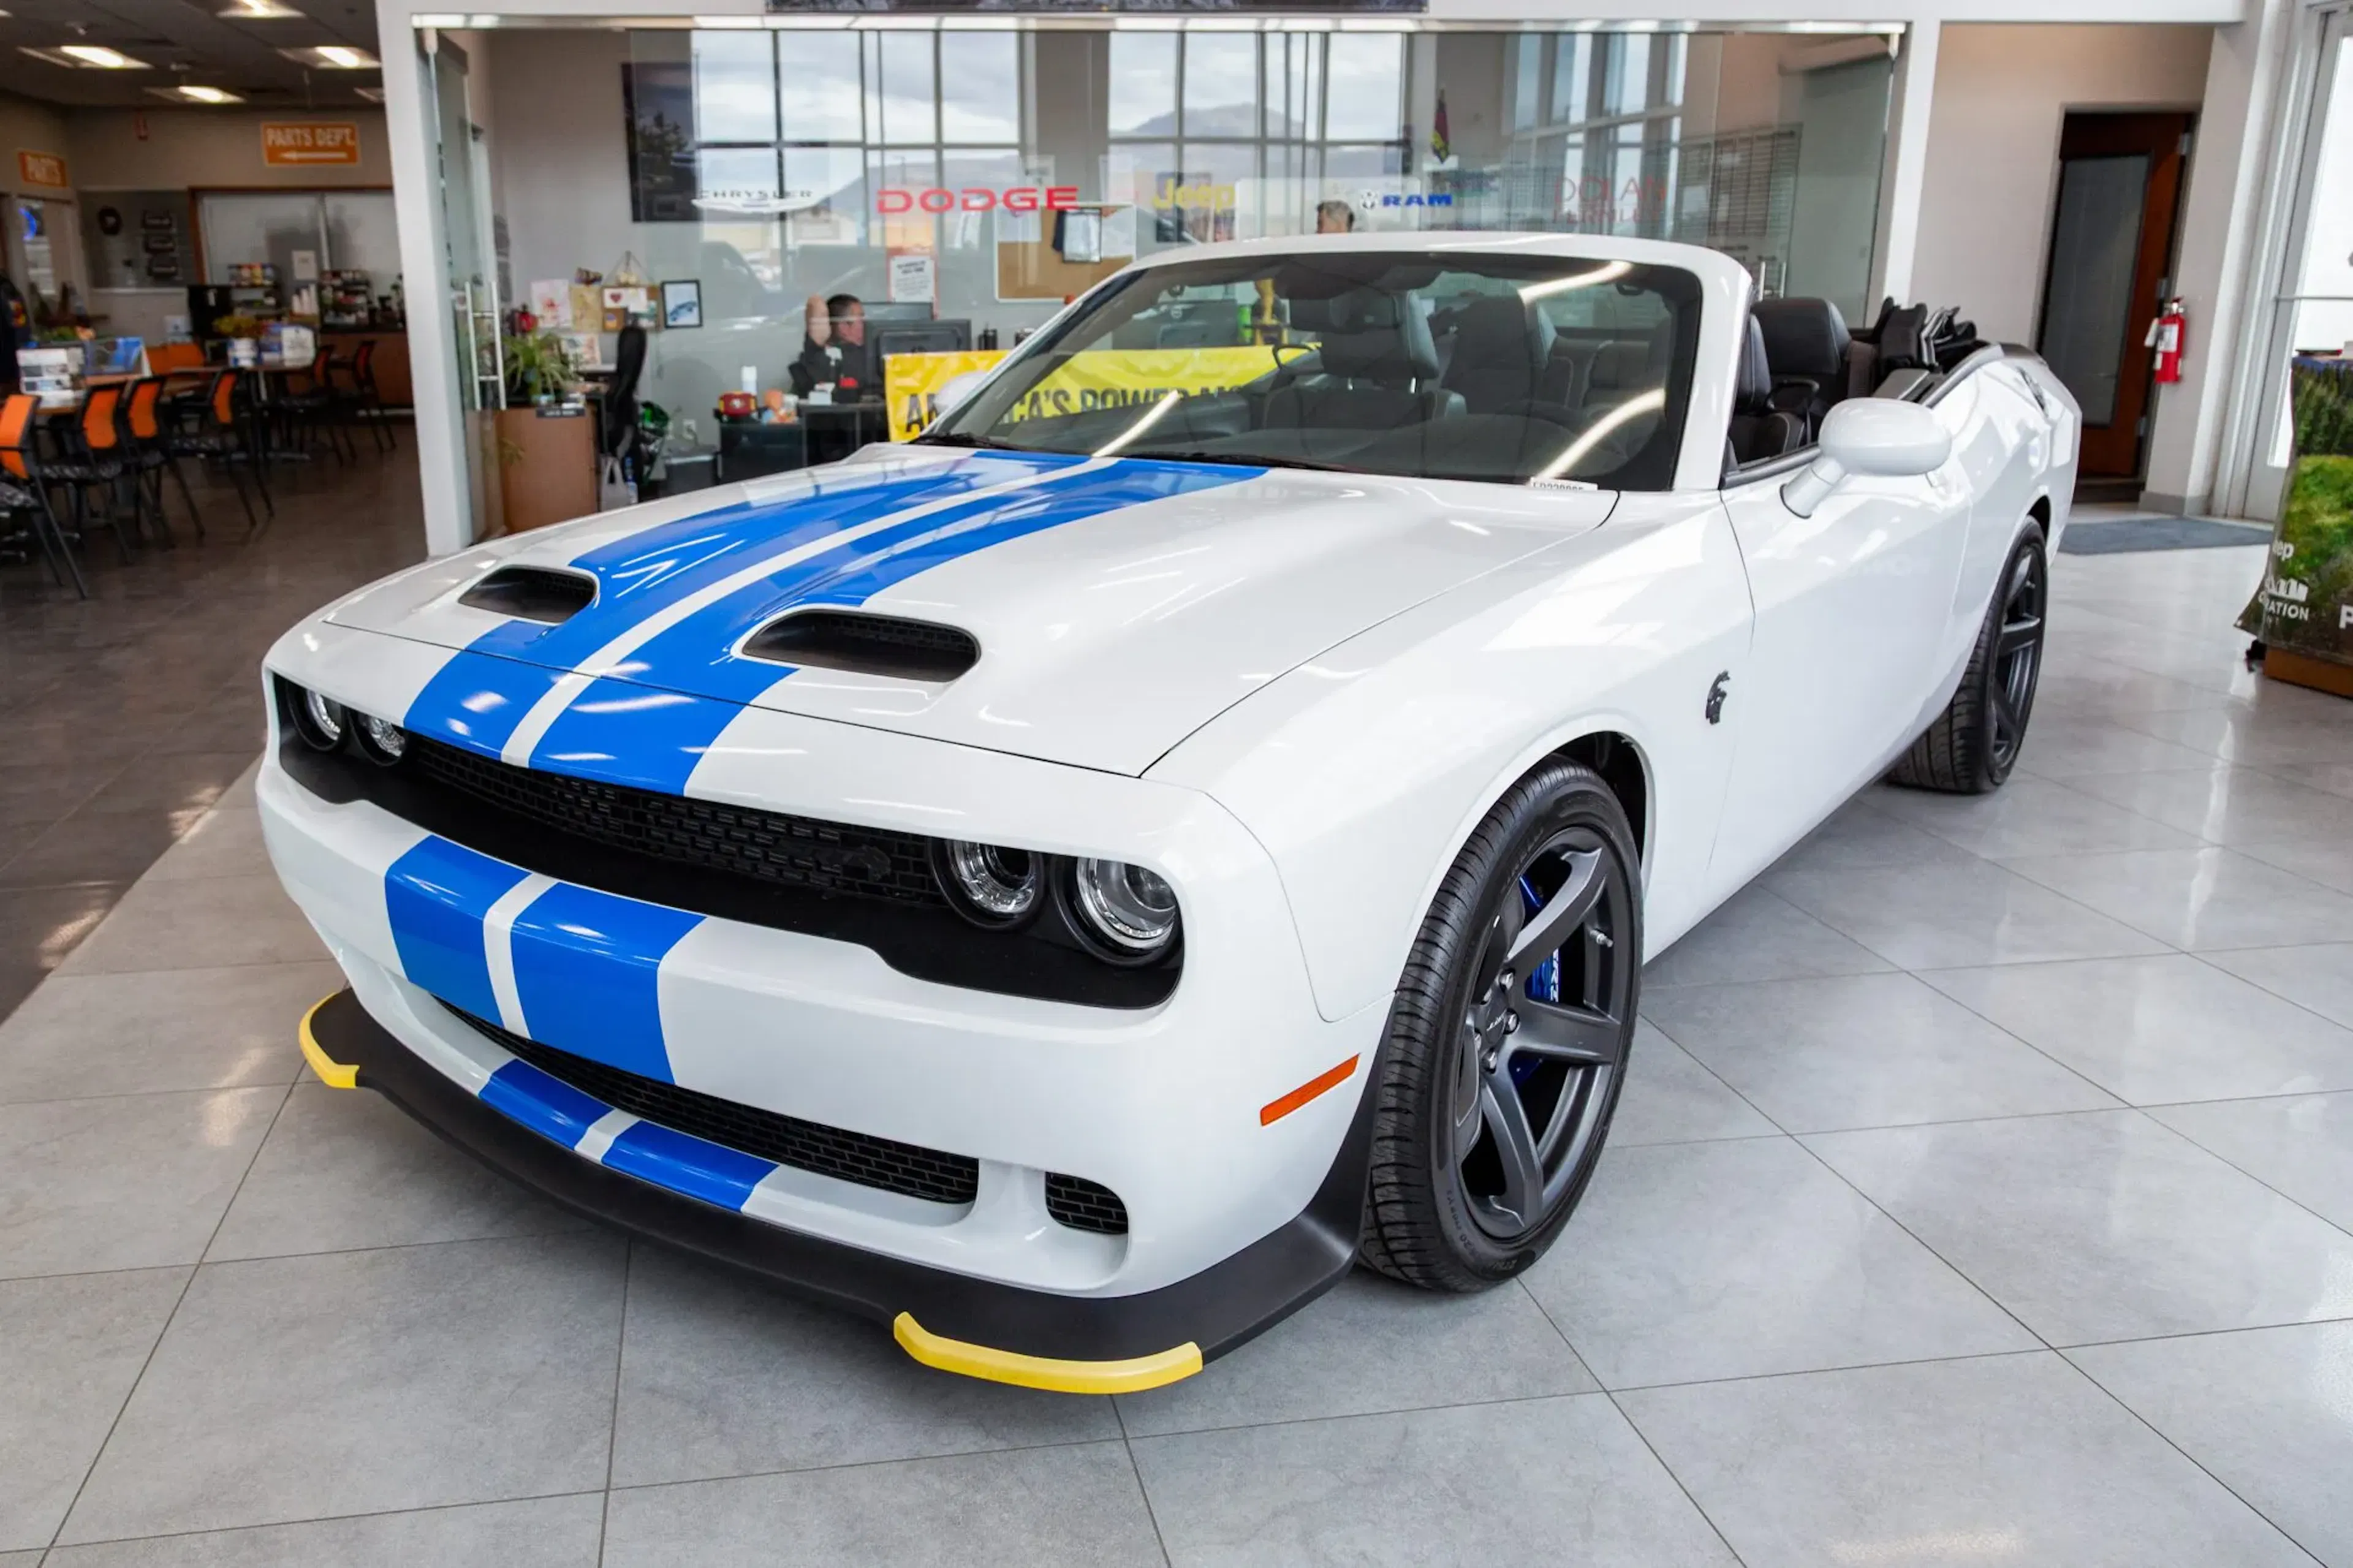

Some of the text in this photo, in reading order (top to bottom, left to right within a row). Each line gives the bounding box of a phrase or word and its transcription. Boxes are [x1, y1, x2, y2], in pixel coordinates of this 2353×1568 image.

[266, 127, 313, 147] PARTS
[877, 186, 1079, 214] DODGE
[1153, 177, 1236, 214] Jeep
[1382, 193, 1452, 207] RAM
